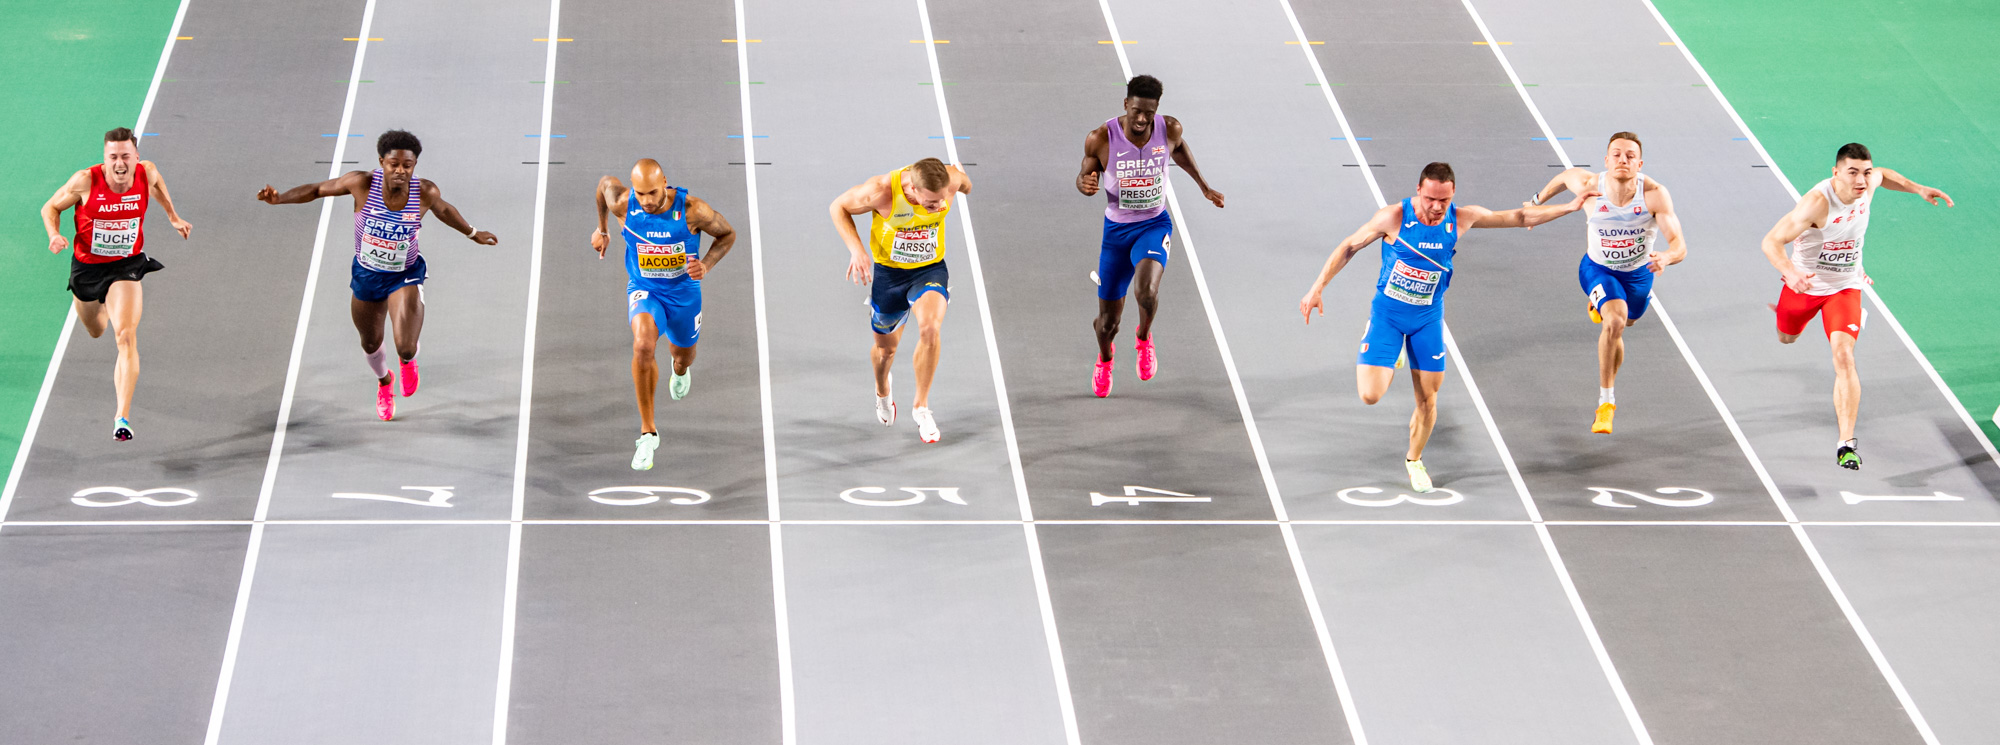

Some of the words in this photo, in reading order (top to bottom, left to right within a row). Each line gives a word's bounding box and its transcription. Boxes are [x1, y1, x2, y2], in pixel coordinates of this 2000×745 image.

[1116, 156, 1164, 170] GREAT
[1116, 166, 1163, 178] BRITAIN
[1121, 179, 1153, 187] SPAR
[1120, 186, 1162, 199] PRESCOD
[98, 202, 139, 213] AUSTRIA
[96, 221, 129, 230] SPAR
[365, 218, 414, 233] GREAT
[94, 232, 137, 244] FUCHS
[363, 226, 410, 241] BRITAIN
[897, 231, 928, 239] SPAR
[1598, 228, 1646, 237] SLOVAKIA
[363, 235, 397, 250] SPAR
[893, 241, 937, 253] LARSSON
[1602, 239, 1634, 248] SPAR
[370, 249, 396, 261] AZU
[638, 245, 672, 254] SPAR
[1602, 244, 1646, 259] VOLKO
[640, 255, 685, 267] JACOBS
[1819, 251, 1859, 262] KOPEC
[1396, 262, 1429, 280] SPAR
[1390, 273, 1435, 294] CECCARELLI
[72, 486, 199, 507] 8
[331, 486, 455, 507] 7
[840, 486, 968, 507] 5
[1091, 486, 1213, 507] 4
[1337, 487, 1464, 507] 3
[1587, 487, 1715, 508] 2
[1840, 491, 1966, 505] 1
